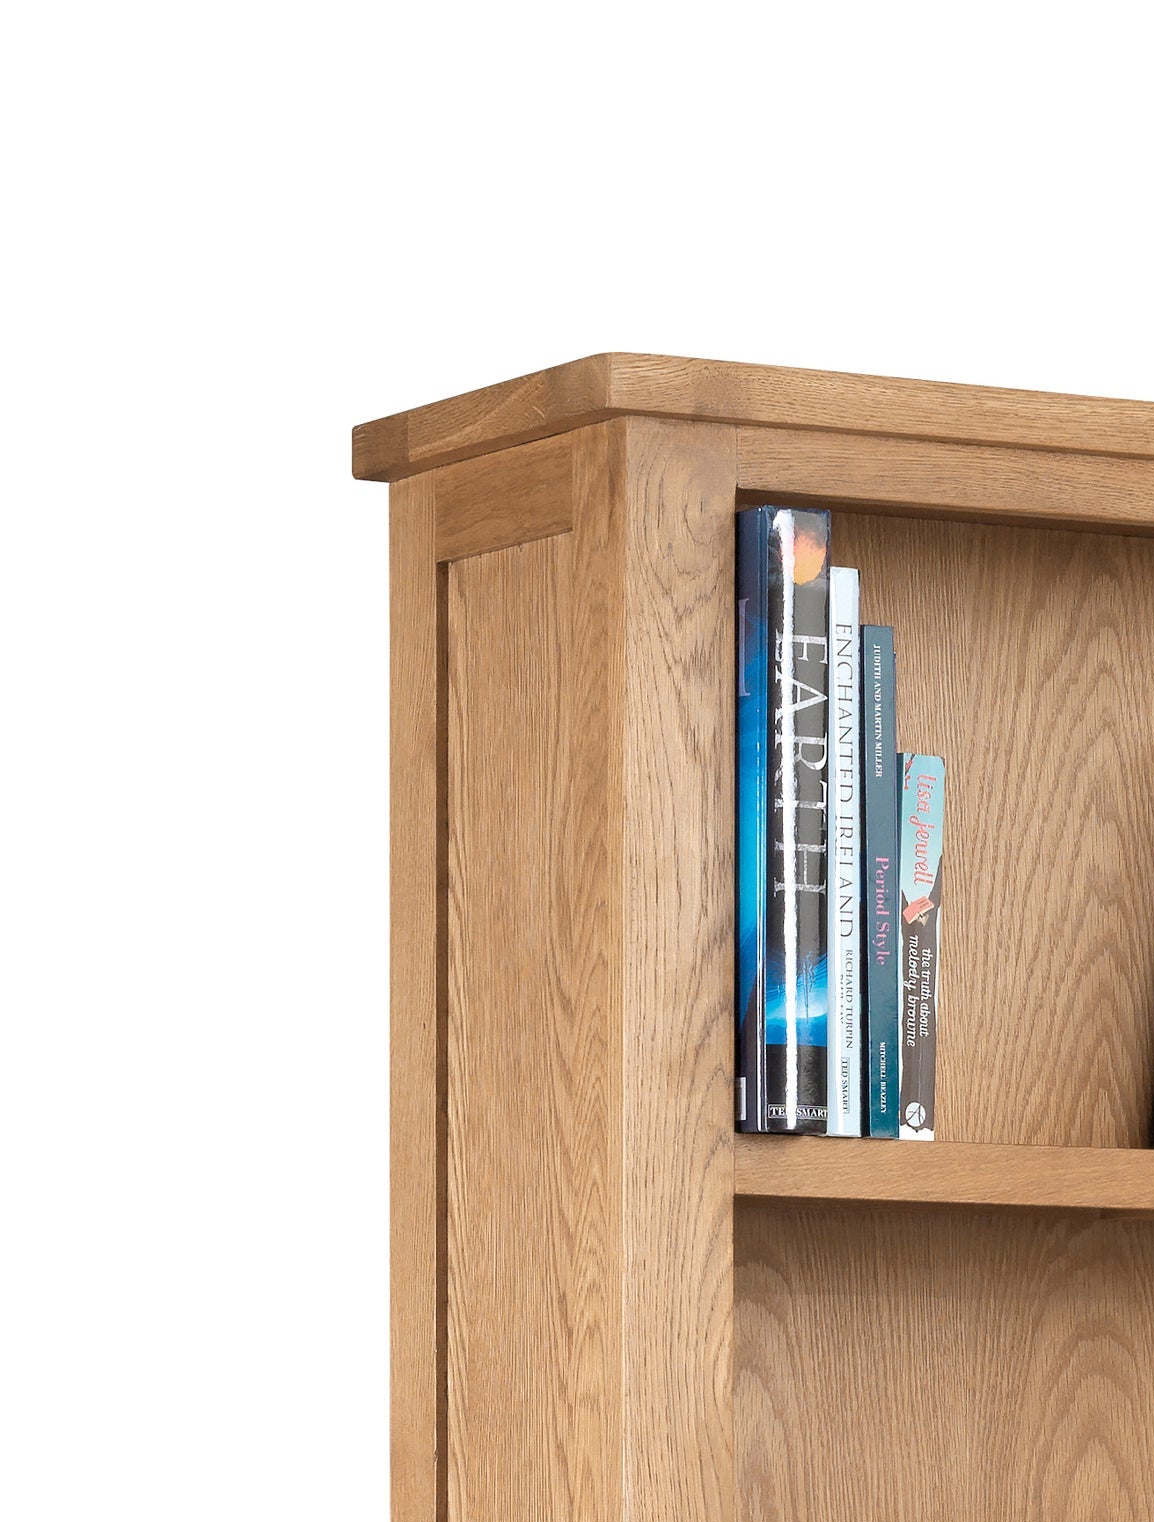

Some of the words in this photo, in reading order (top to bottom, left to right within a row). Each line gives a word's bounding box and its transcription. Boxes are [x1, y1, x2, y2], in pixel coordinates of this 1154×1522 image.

[873, 644, 881, 679] JUDITH
[874, 680, 882, 700] AND
[836, 624, 853, 803] ENCHANTED
[874, 703, 882, 742] MARTIN
[774, 629, 828, 897] EARTH
[875, 743, 883, 778] MILLER
[839, 815, 853, 937] IRELAND
[875, 857, 889, 916] Period
[872, 921, 890, 966] Style
[904, 935, 920, 991] melody
[922, 948, 934, 970] the
[845, 949, 853, 1003] RICHARD
[920, 971, 932, 1000] truth
[845, 1006, 853, 1049] TURPIN
[906, 995, 920, 1047] browne
[919, 1001, 931, 1038] about
[841, 1079, 849, 1110] SMART
